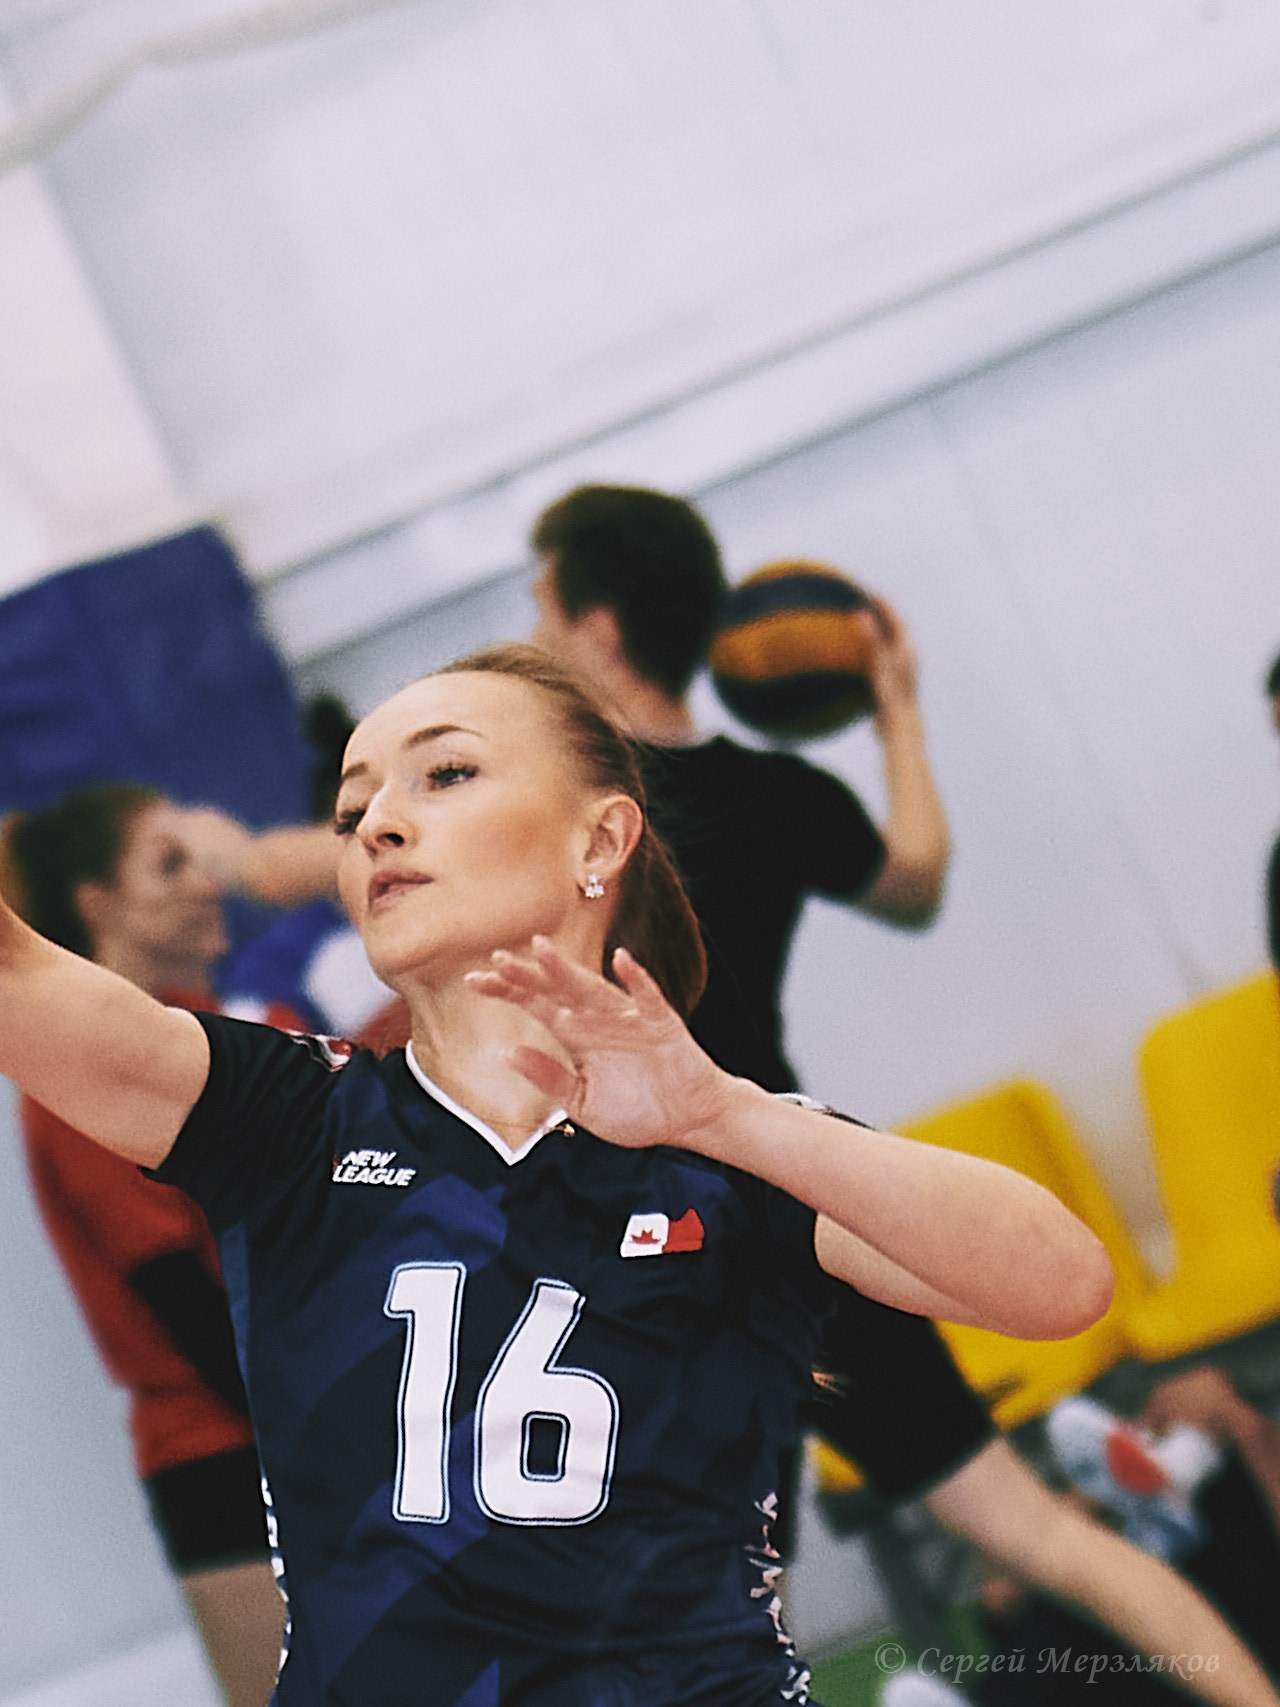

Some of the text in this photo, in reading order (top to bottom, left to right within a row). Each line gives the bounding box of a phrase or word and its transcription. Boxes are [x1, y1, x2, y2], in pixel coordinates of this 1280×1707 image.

[341, 1149, 397, 1168] NEW
[332, 1164, 417, 1187] LEAGUE
[383, 1261, 620, 1527] 16
